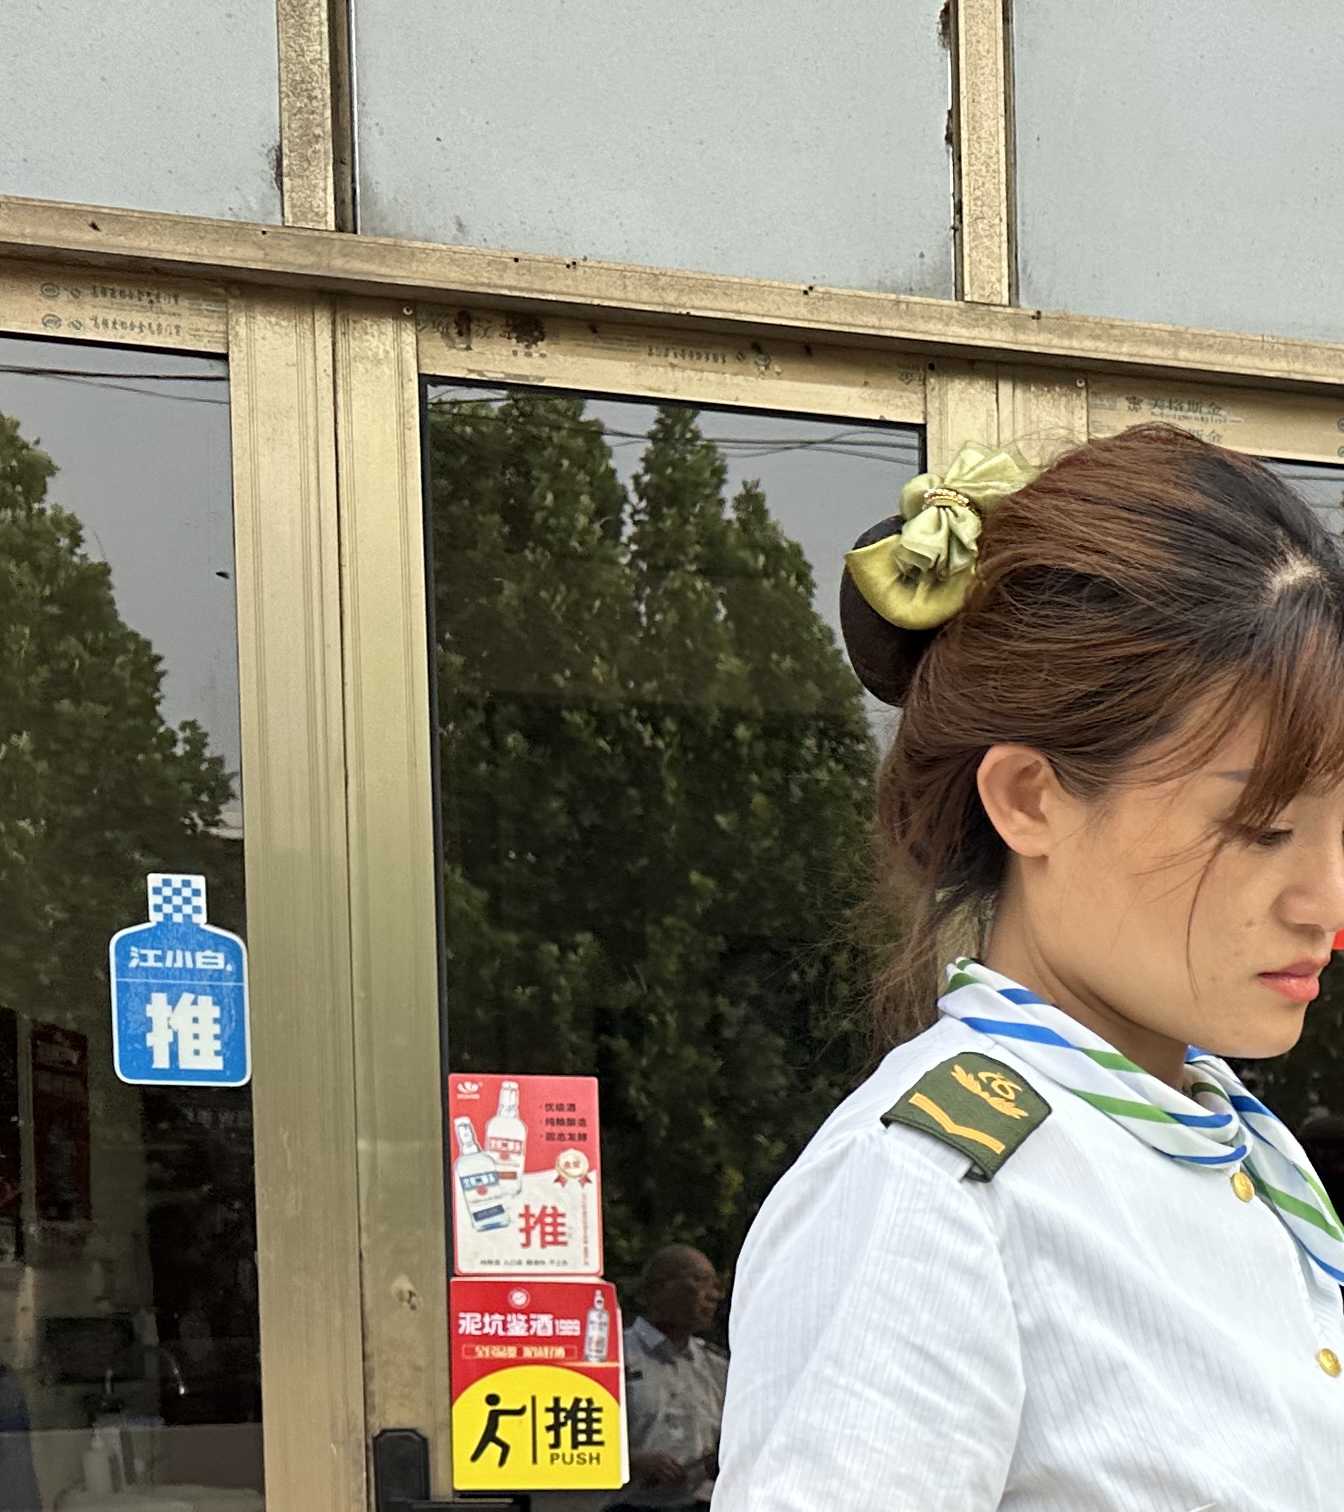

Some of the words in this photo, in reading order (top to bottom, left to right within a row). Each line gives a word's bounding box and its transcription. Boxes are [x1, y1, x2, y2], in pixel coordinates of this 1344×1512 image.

[128, 945, 225, 970] 江小白
[146, 992, 223, 1070] 推
[519, 1204, 568, 1249] 推
[545, 1396, 605, 1450] 推
[550, 1452, 601, 1466] PUSH
